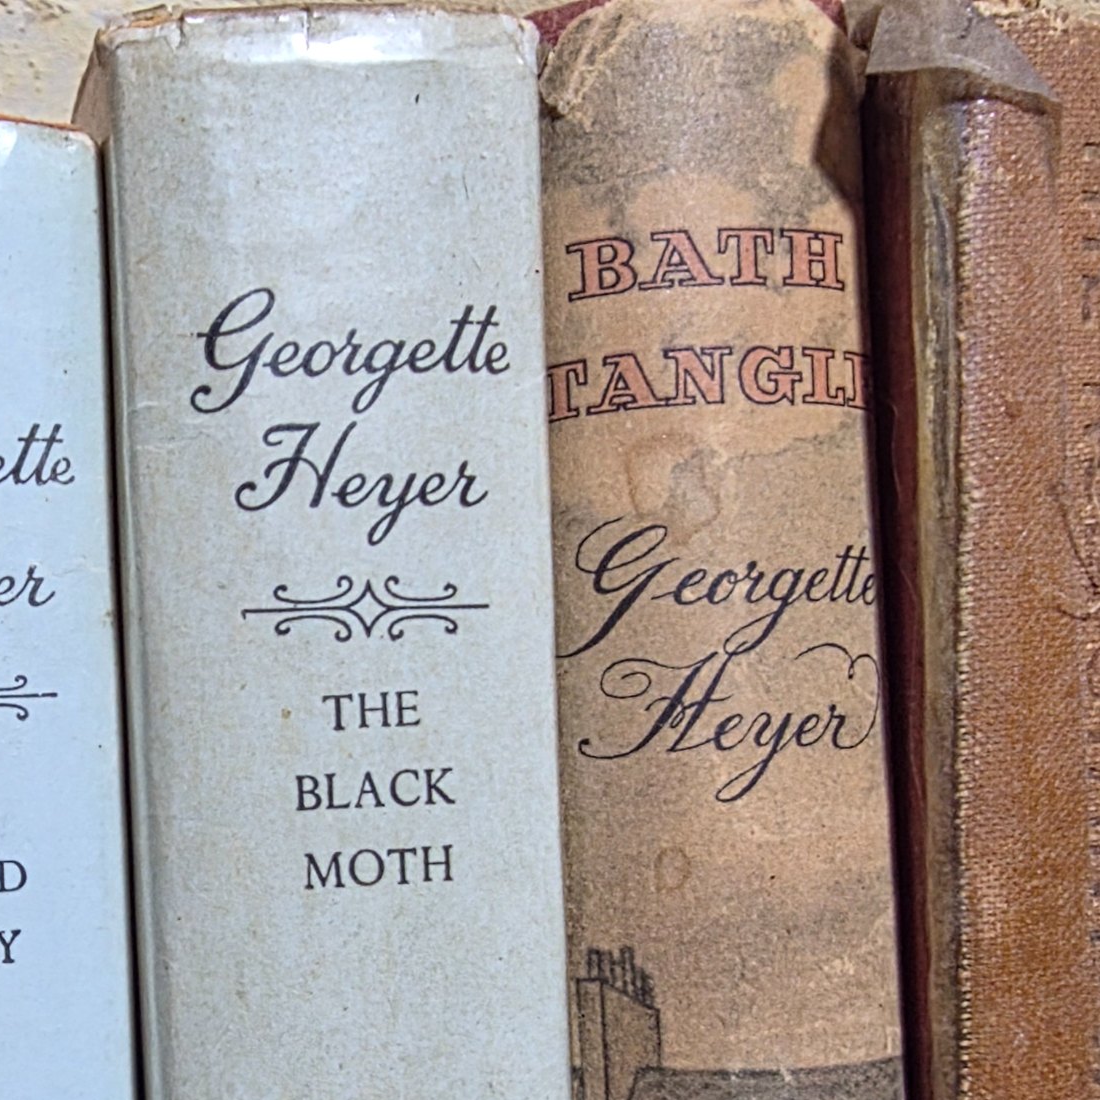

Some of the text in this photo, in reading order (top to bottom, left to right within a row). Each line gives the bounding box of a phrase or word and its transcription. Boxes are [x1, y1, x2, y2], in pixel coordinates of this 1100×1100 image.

[565, 227, 845, 302] BATH
[190, 287, 512, 414] Georgette
[235, 421, 489, 546] Heyer
[321, 689, 422, 732] THE
[578, 642, 882, 803] Heyer
[294, 767, 456, 812] BLACK
[303, 844, 455, 890] MOTH
